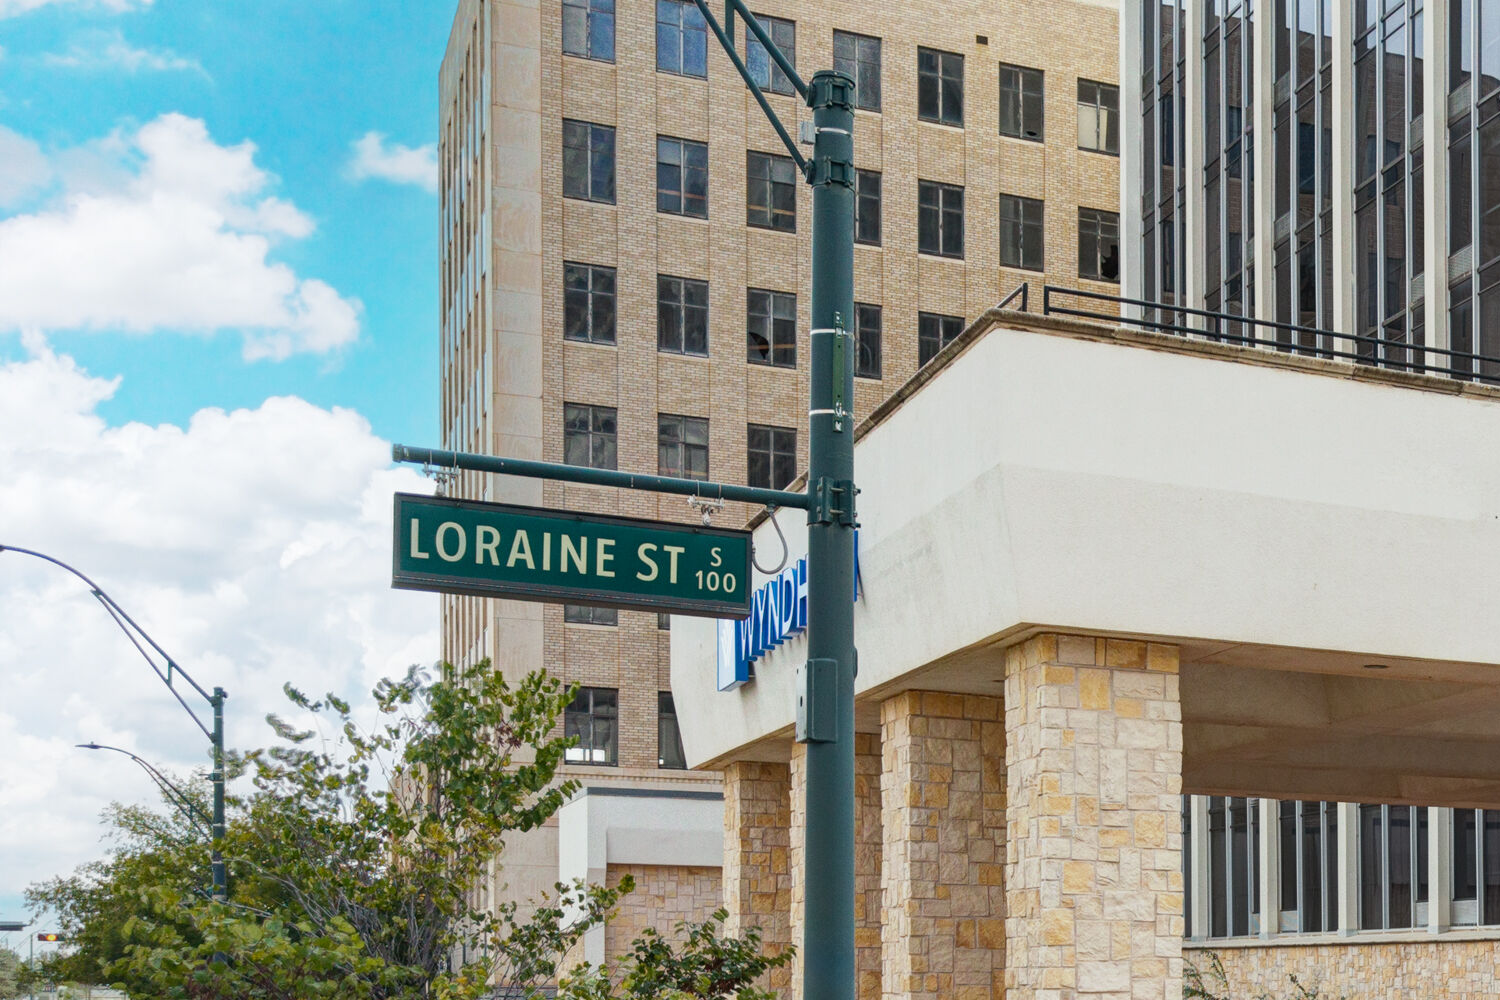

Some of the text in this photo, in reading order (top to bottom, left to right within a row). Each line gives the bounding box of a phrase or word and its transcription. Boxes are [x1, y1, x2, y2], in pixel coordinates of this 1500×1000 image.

[410, 518, 685, 584] LORAINE ST
[710, 547, 722, 567] S
[695, 570, 736, 593] 100
[738, 552, 809, 661] WYNDH
